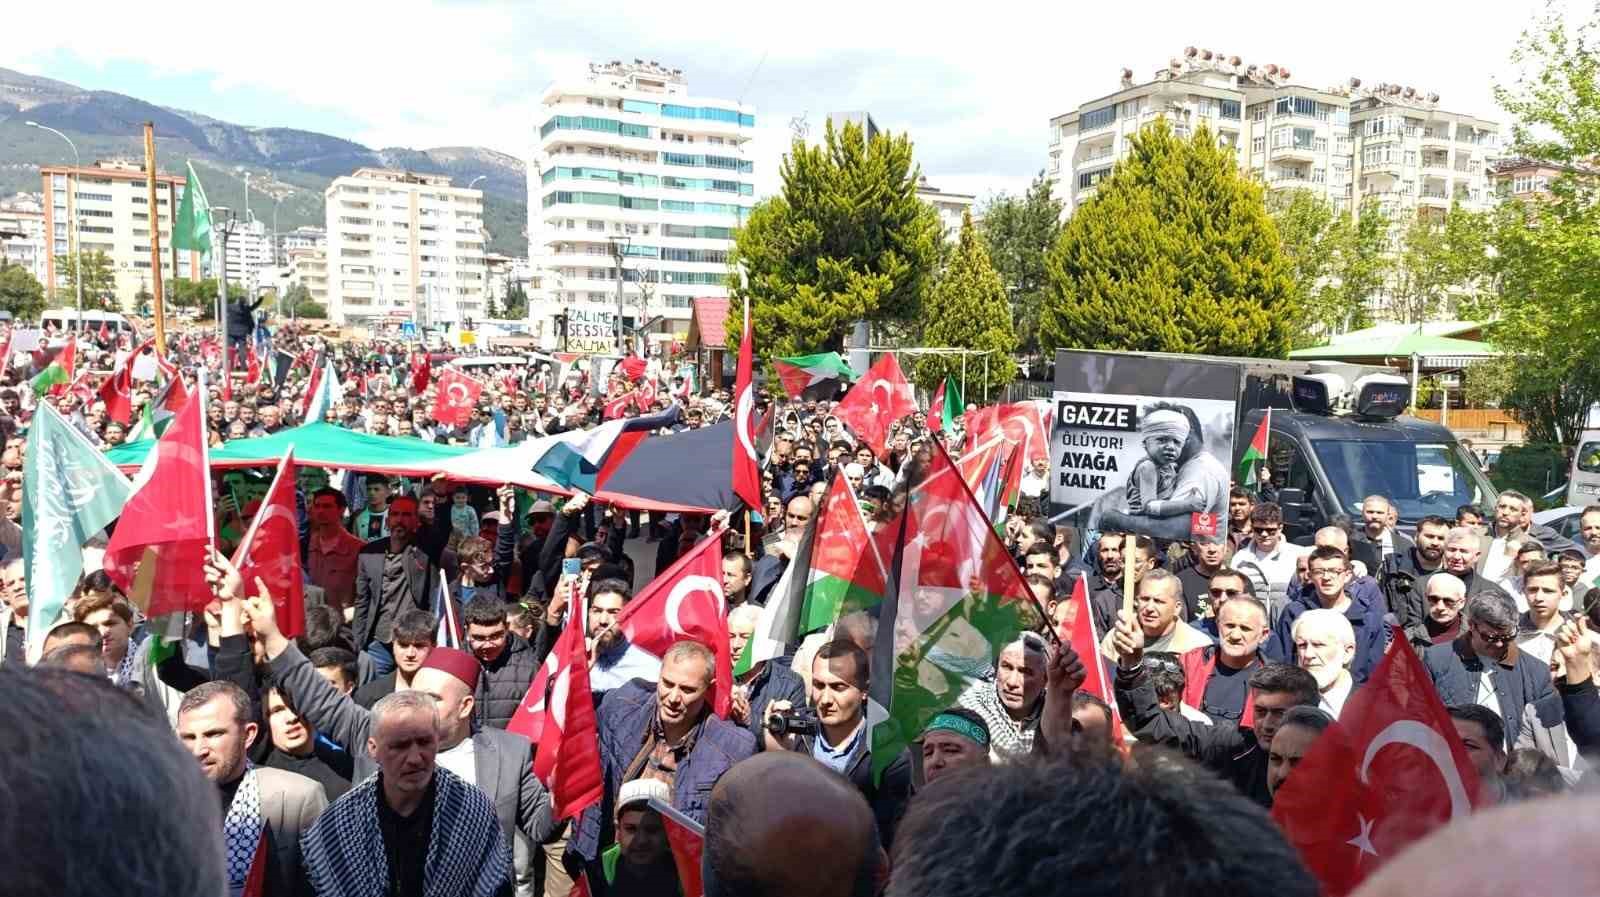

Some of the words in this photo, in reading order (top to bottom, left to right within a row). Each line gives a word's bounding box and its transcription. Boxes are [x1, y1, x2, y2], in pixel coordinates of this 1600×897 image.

[1063, 405, 1129, 427] GAZZE
[1062, 430, 1123, 450] ÖLÜYOR!
[1060, 451, 1119, 472] AYAĞA
[1060, 472, 1106, 490] KALK!
